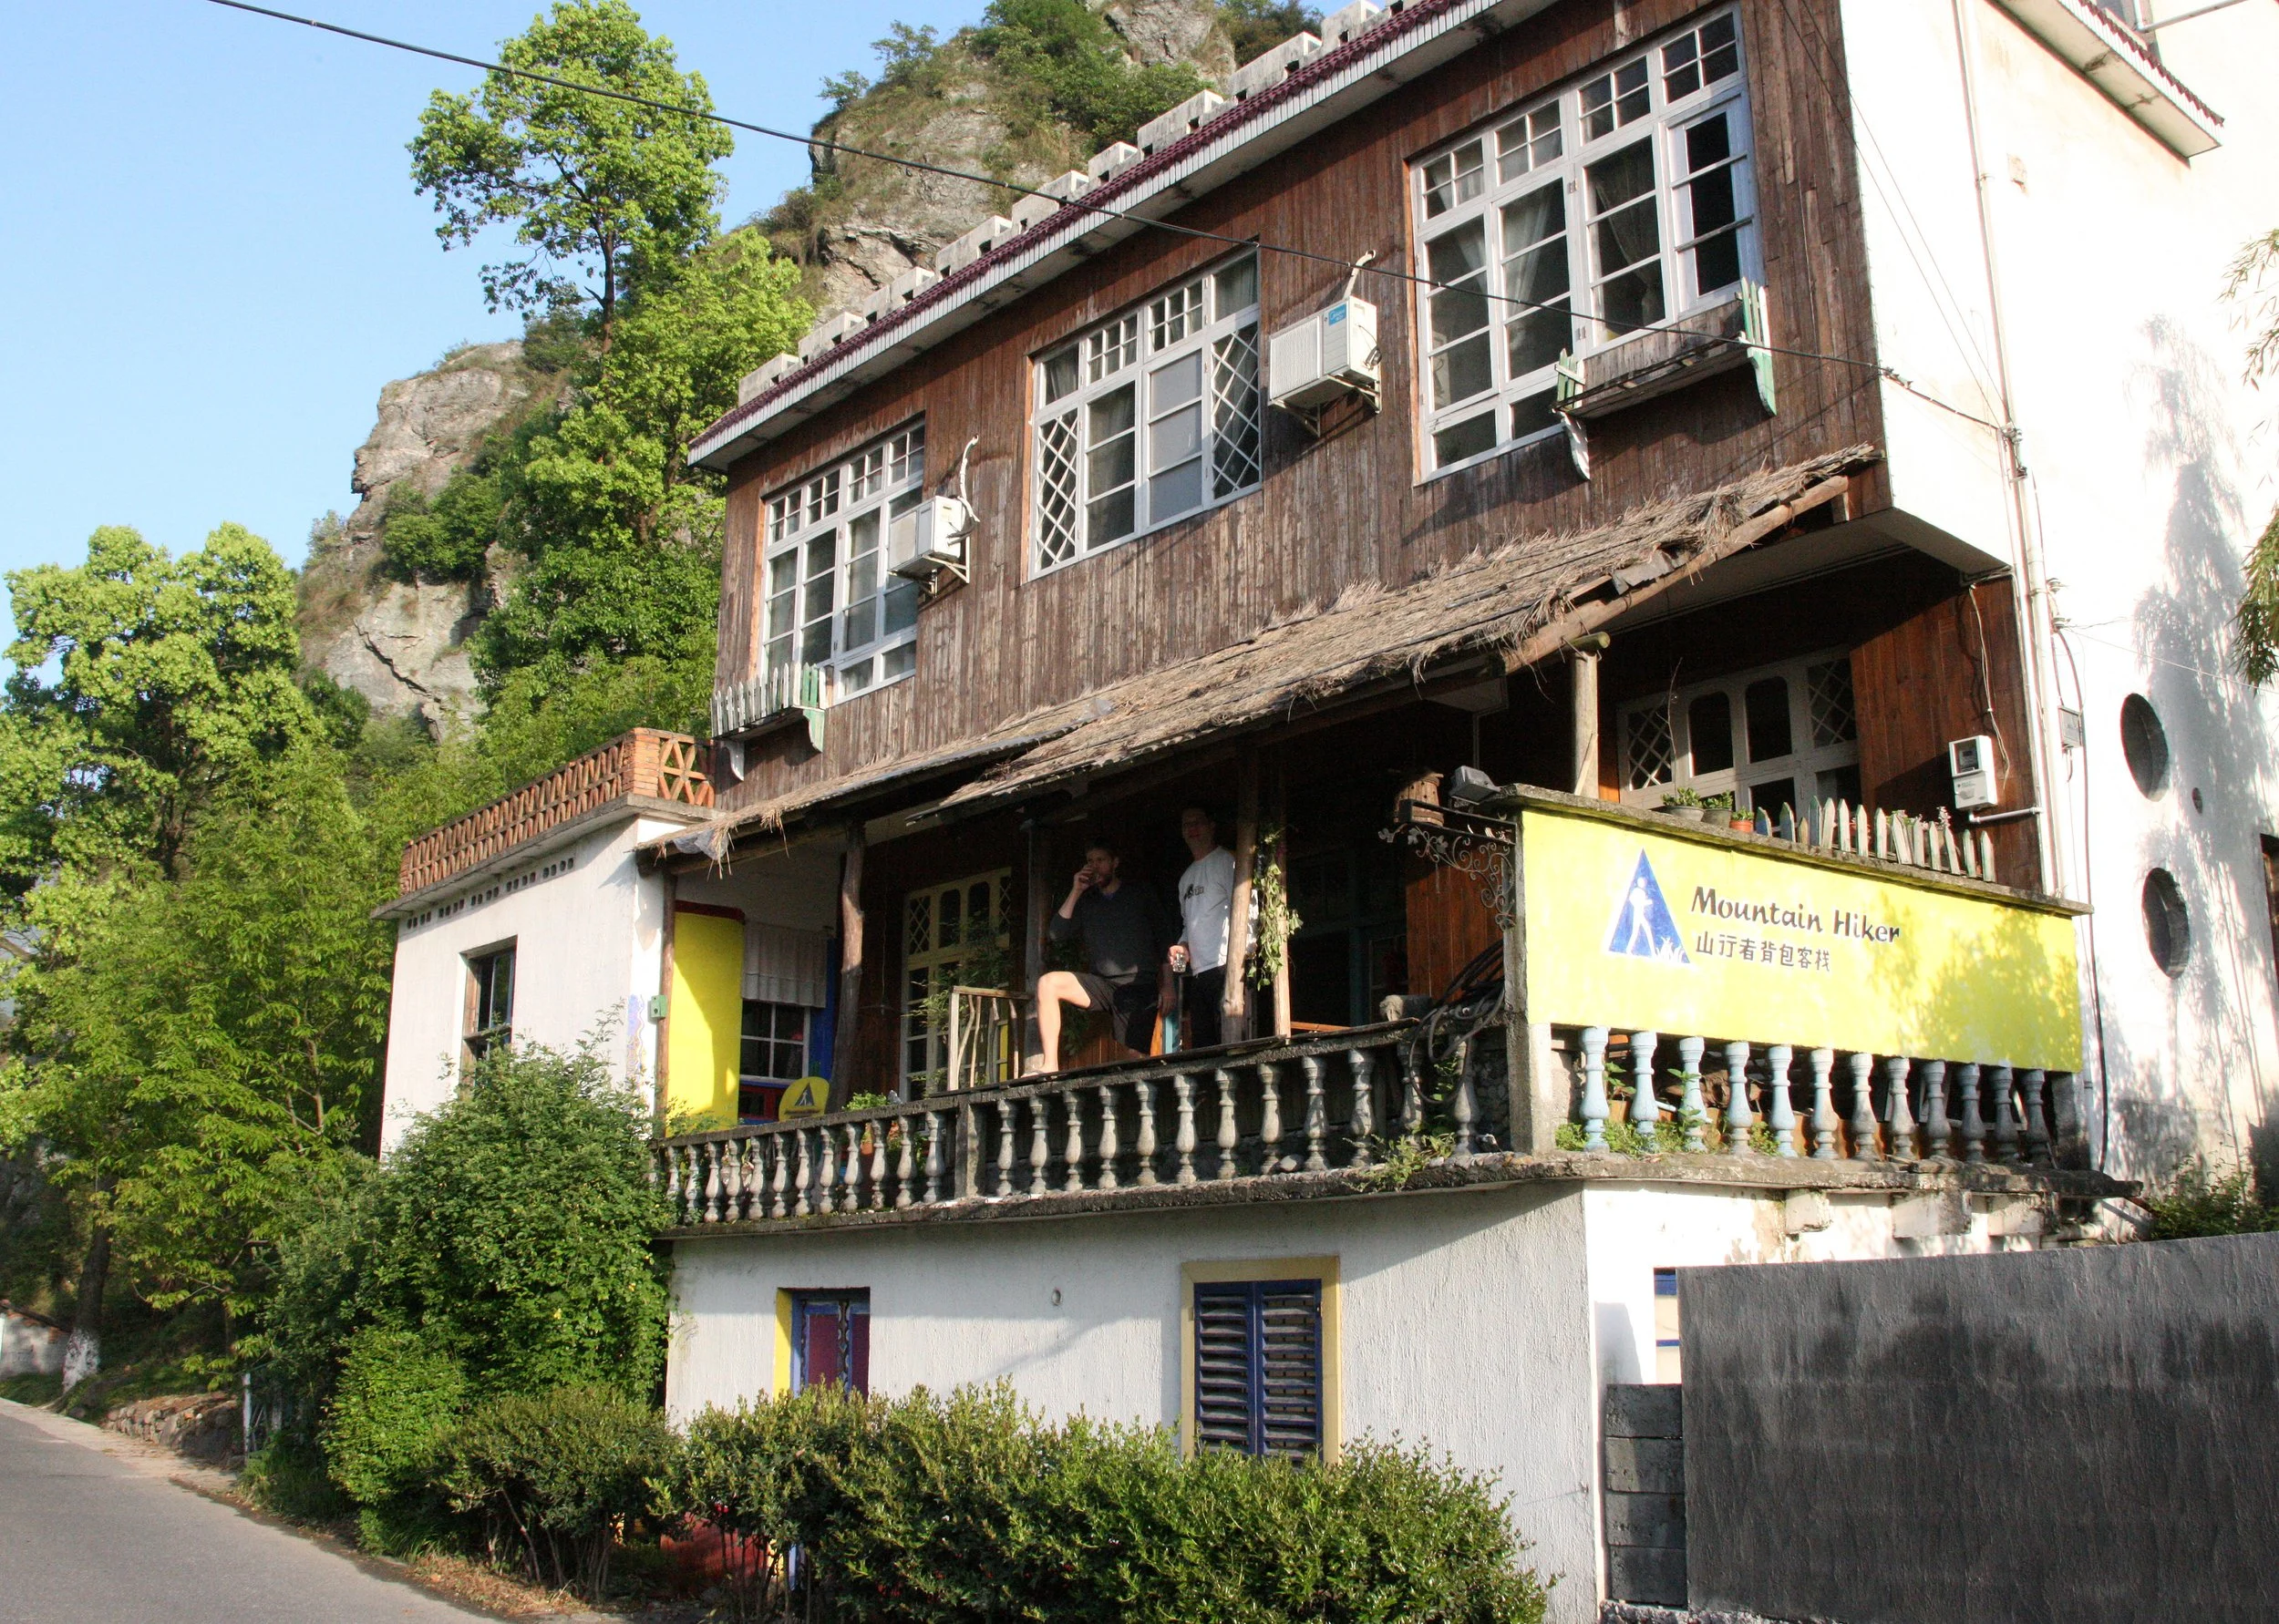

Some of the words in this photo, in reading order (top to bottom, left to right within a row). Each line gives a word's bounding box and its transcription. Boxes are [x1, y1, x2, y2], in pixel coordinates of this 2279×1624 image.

[1691, 886, 1822, 932] Mountain
[1833, 910, 1900, 942] Hiker
[1696, 930, 1830, 971] 山行者背包客栈
